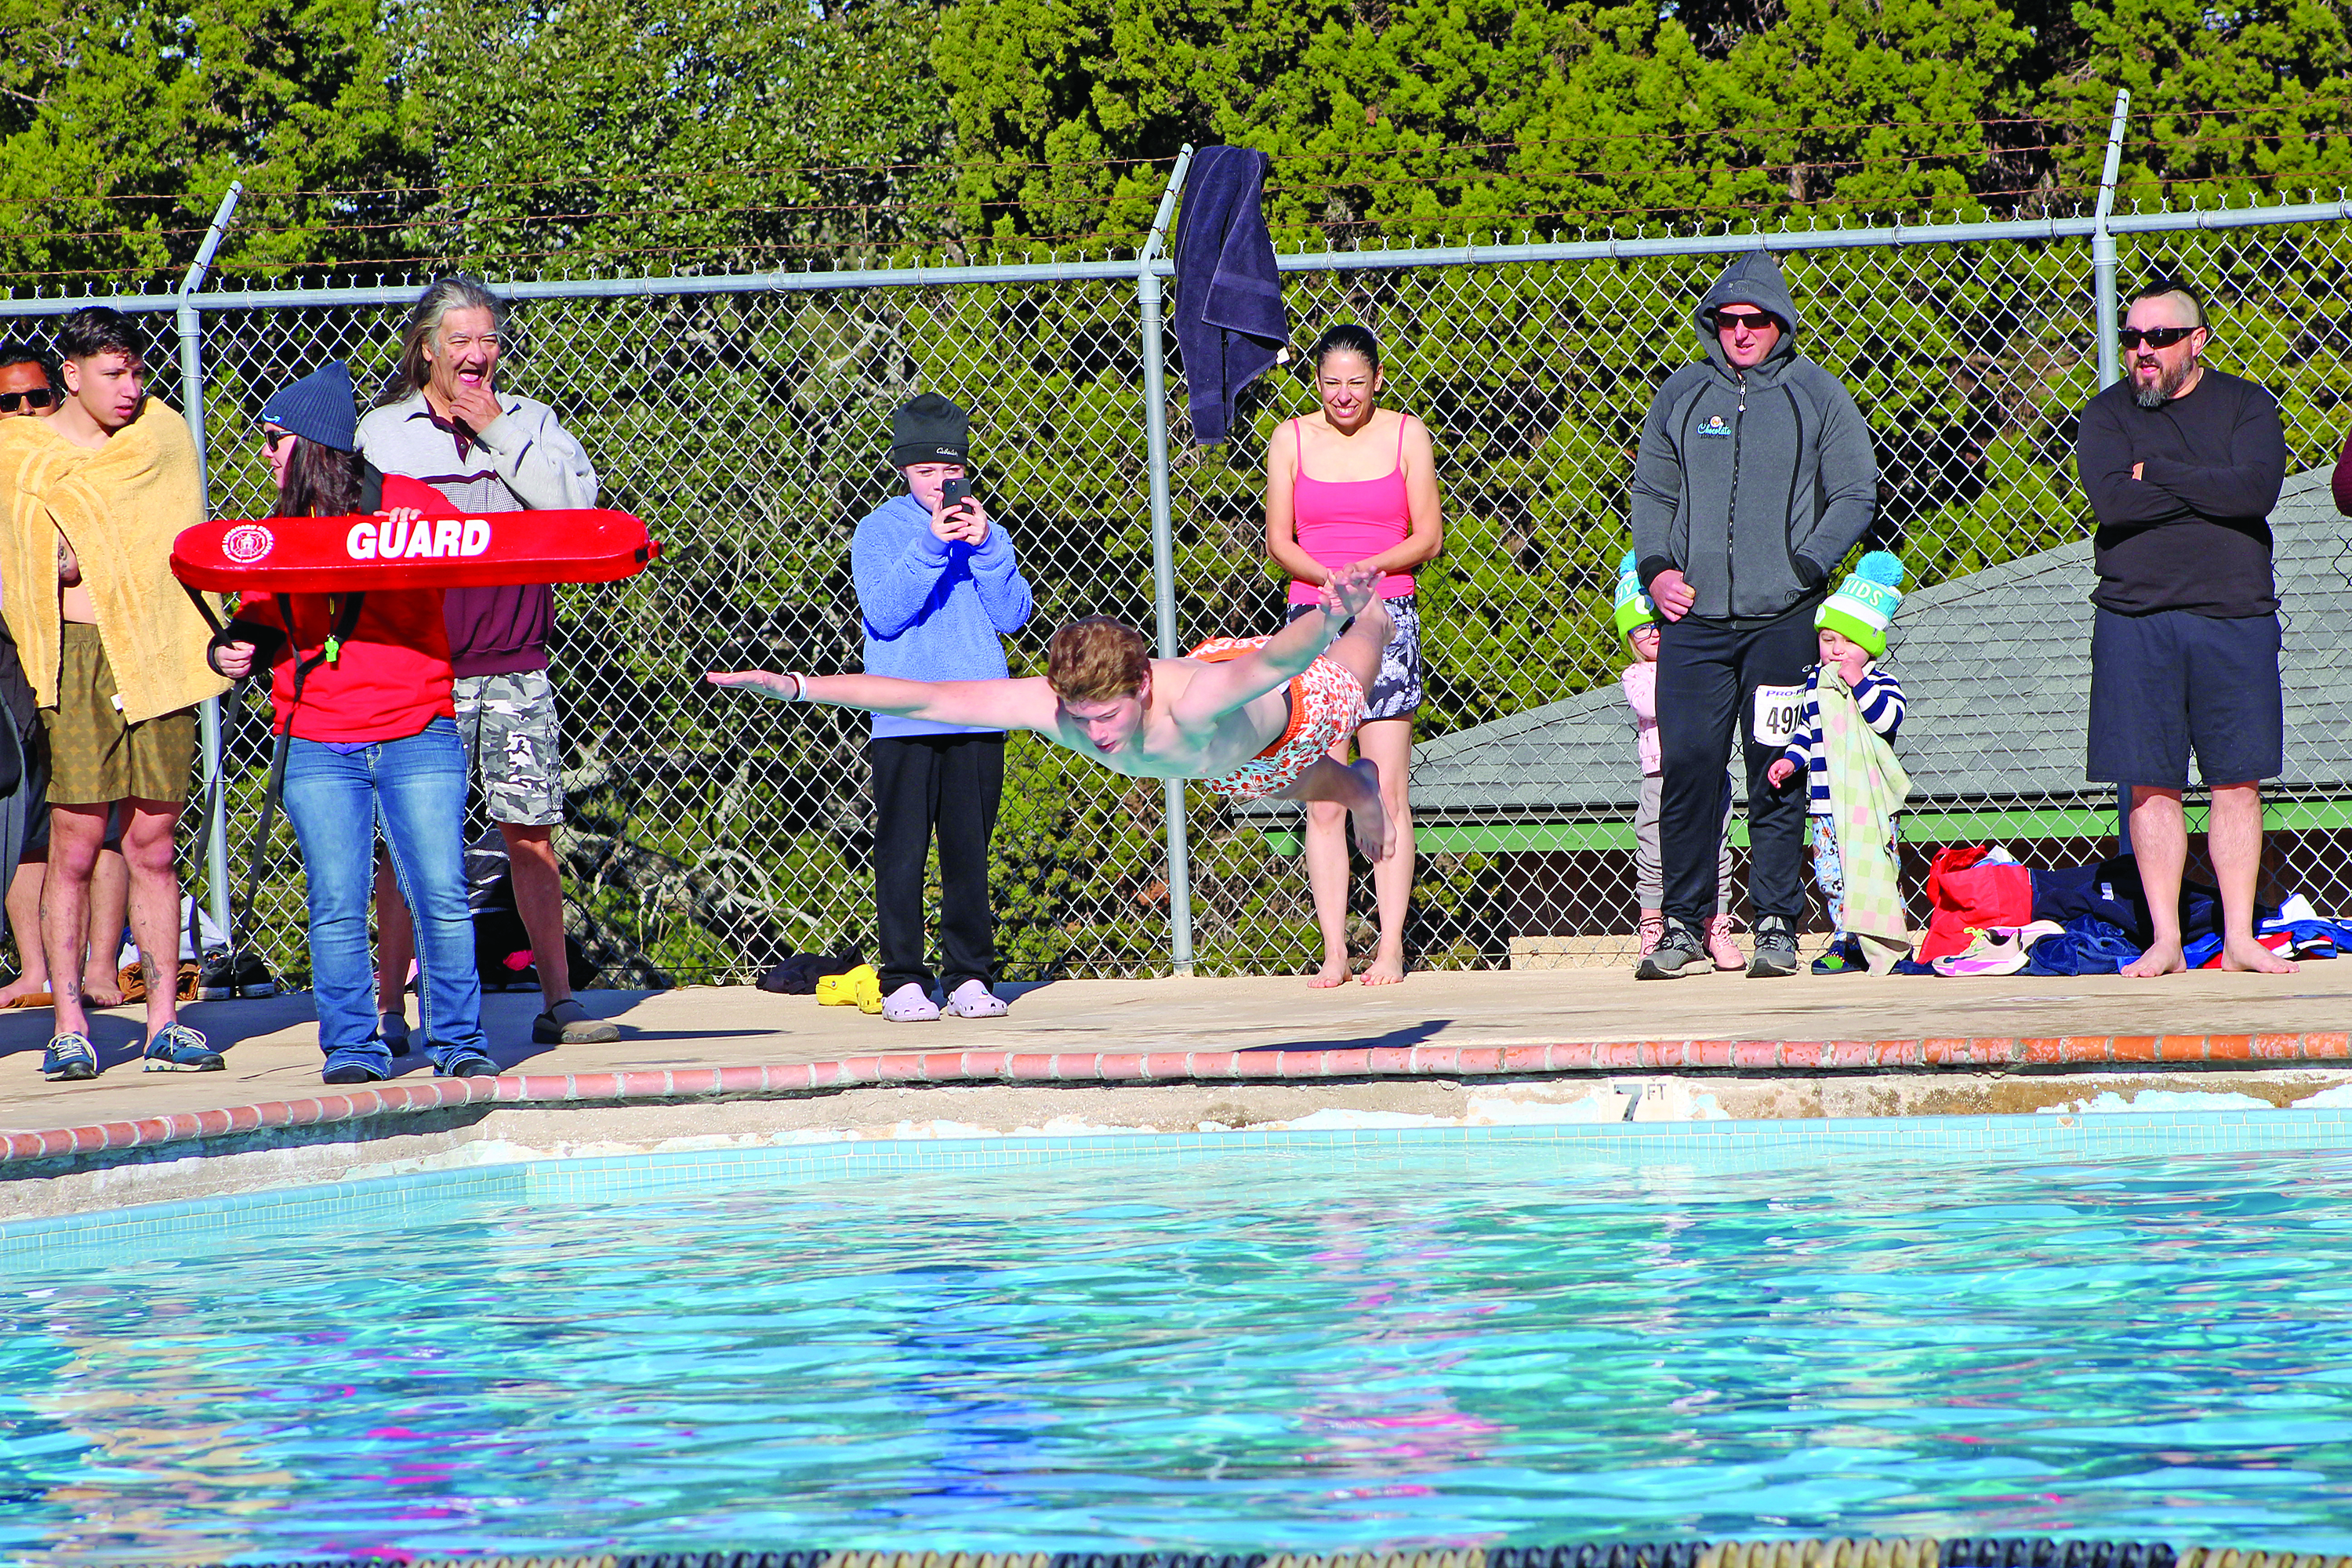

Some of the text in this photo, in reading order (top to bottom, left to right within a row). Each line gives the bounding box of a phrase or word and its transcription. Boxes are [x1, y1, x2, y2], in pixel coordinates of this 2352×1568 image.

[1697, 423, 1732, 435] Chocolate
[347, 519, 491, 559] GUARD
[1840, 579, 1884, 607] KIDS
[1614, 1083, 1667, 1121] 7 FT
